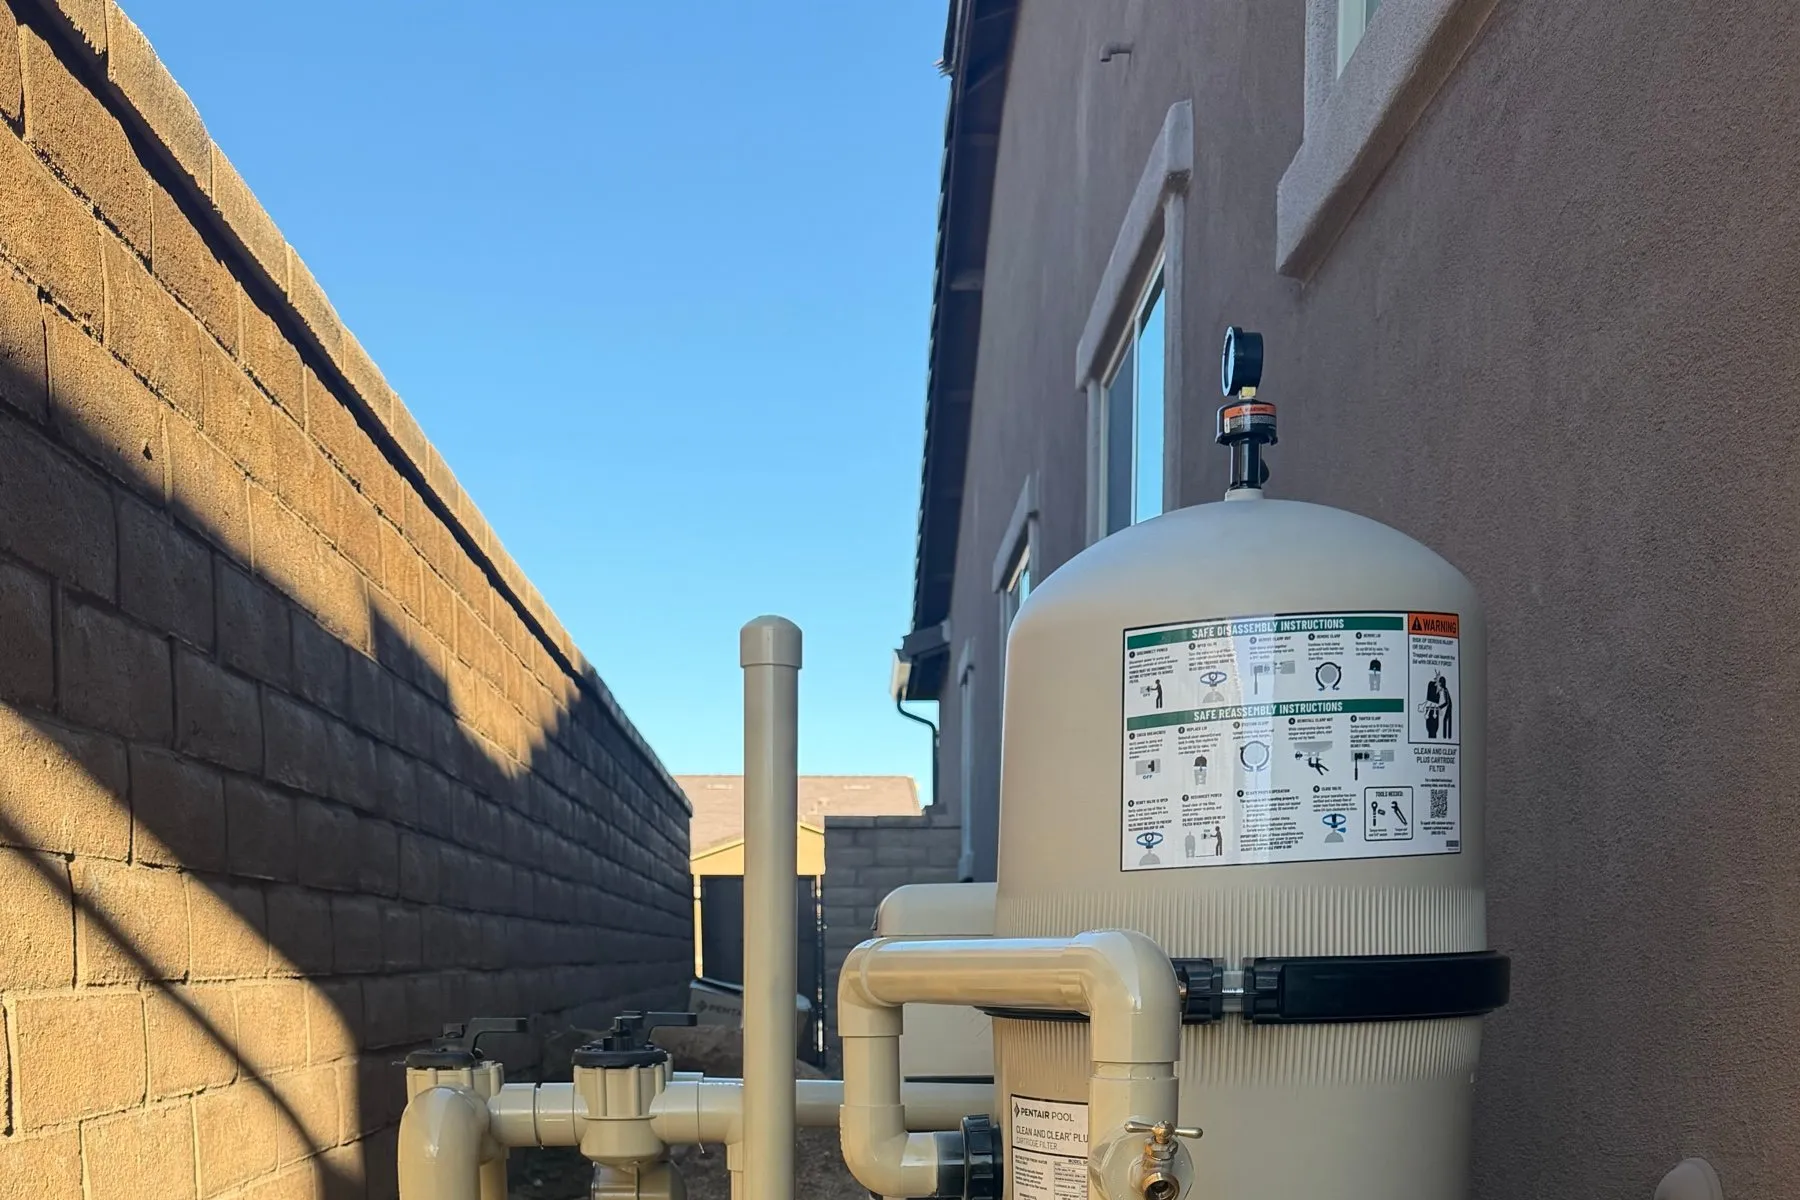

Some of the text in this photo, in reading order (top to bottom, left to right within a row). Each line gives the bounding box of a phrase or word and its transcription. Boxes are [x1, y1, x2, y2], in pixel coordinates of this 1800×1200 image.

[1192, 619, 1344, 639] SAFE DISASSEMBLY INSTRUCTIONS
[1422, 618, 1456, 634] WARNING
[1194, 702, 1343, 721] SAFE REASSEMBLY INSTRUCTIONS
[1020, 1108, 1074, 1122] PENTAIR POOL
[1016, 1125, 1032, 1136] CLEAN
[1034, 1129, 1045, 1138] AND
[1040, 1141, 1057, 1150] FILTER
